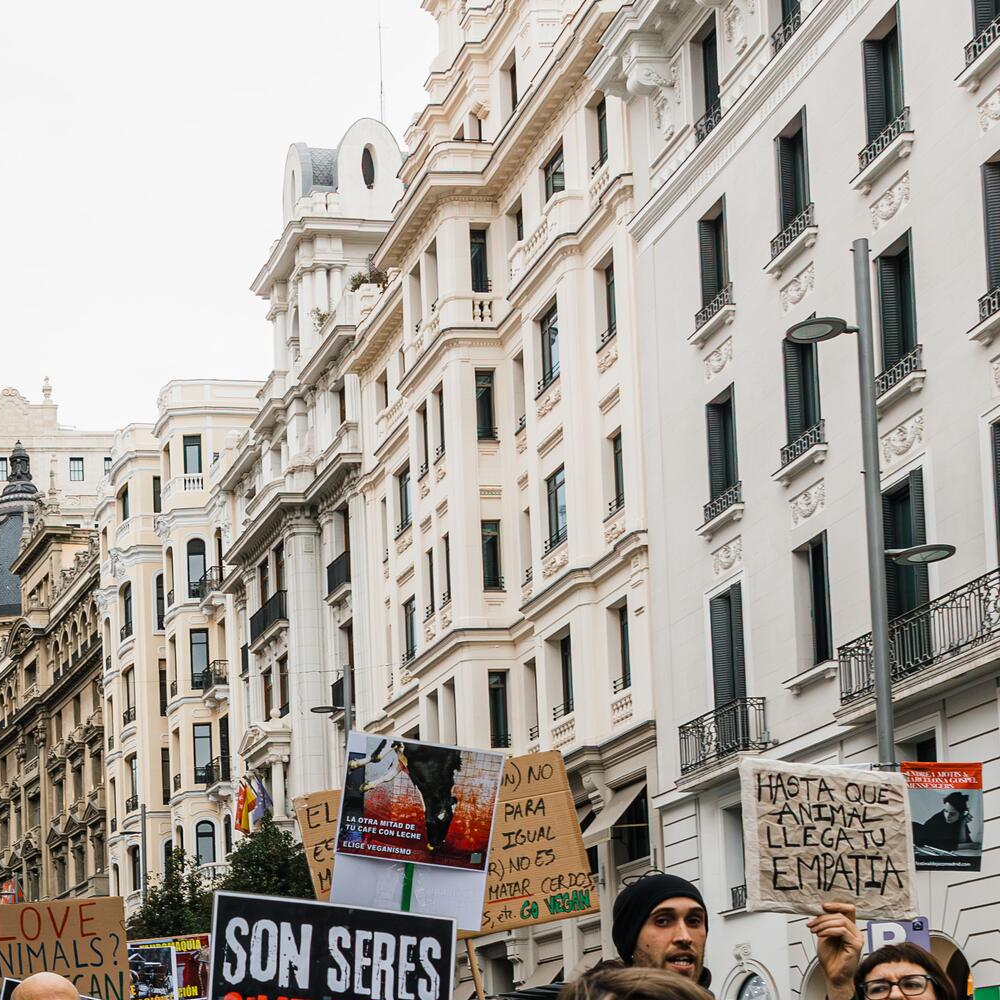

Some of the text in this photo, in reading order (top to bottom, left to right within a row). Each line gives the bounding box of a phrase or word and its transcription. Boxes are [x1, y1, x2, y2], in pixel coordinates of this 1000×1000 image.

[527, 763, 553, 784] NO
[757, 773, 888, 805] HASTA QUE
[306, 801, 337, 830] EL
[504, 797, 546, 823] PARA
[769, 802, 883, 828] ANIMAL
[357, 817, 378, 826] OTRA
[380, 820, 403, 829] MITAD
[404, 823, 416, 831] DE
[378, 828, 395, 837] CON
[396, 832, 422, 840] LECHE
[342, 840, 412, 856] ELIGE VEGANISMO
[502, 825, 556, 851] IGUAL
[767, 825, 886, 850] LLEGA TU
[509, 856, 531, 873] NO
[535, 848, 556, 868] ES
[772, 851, 905, 896] EMPATÍA
[488, 872, 596, 900] MATAR CERDOS,
[519, 900, 539, 920] GO
[543, 888, 592, 915] VEGAN
[222, 917, 313, 989] SON
